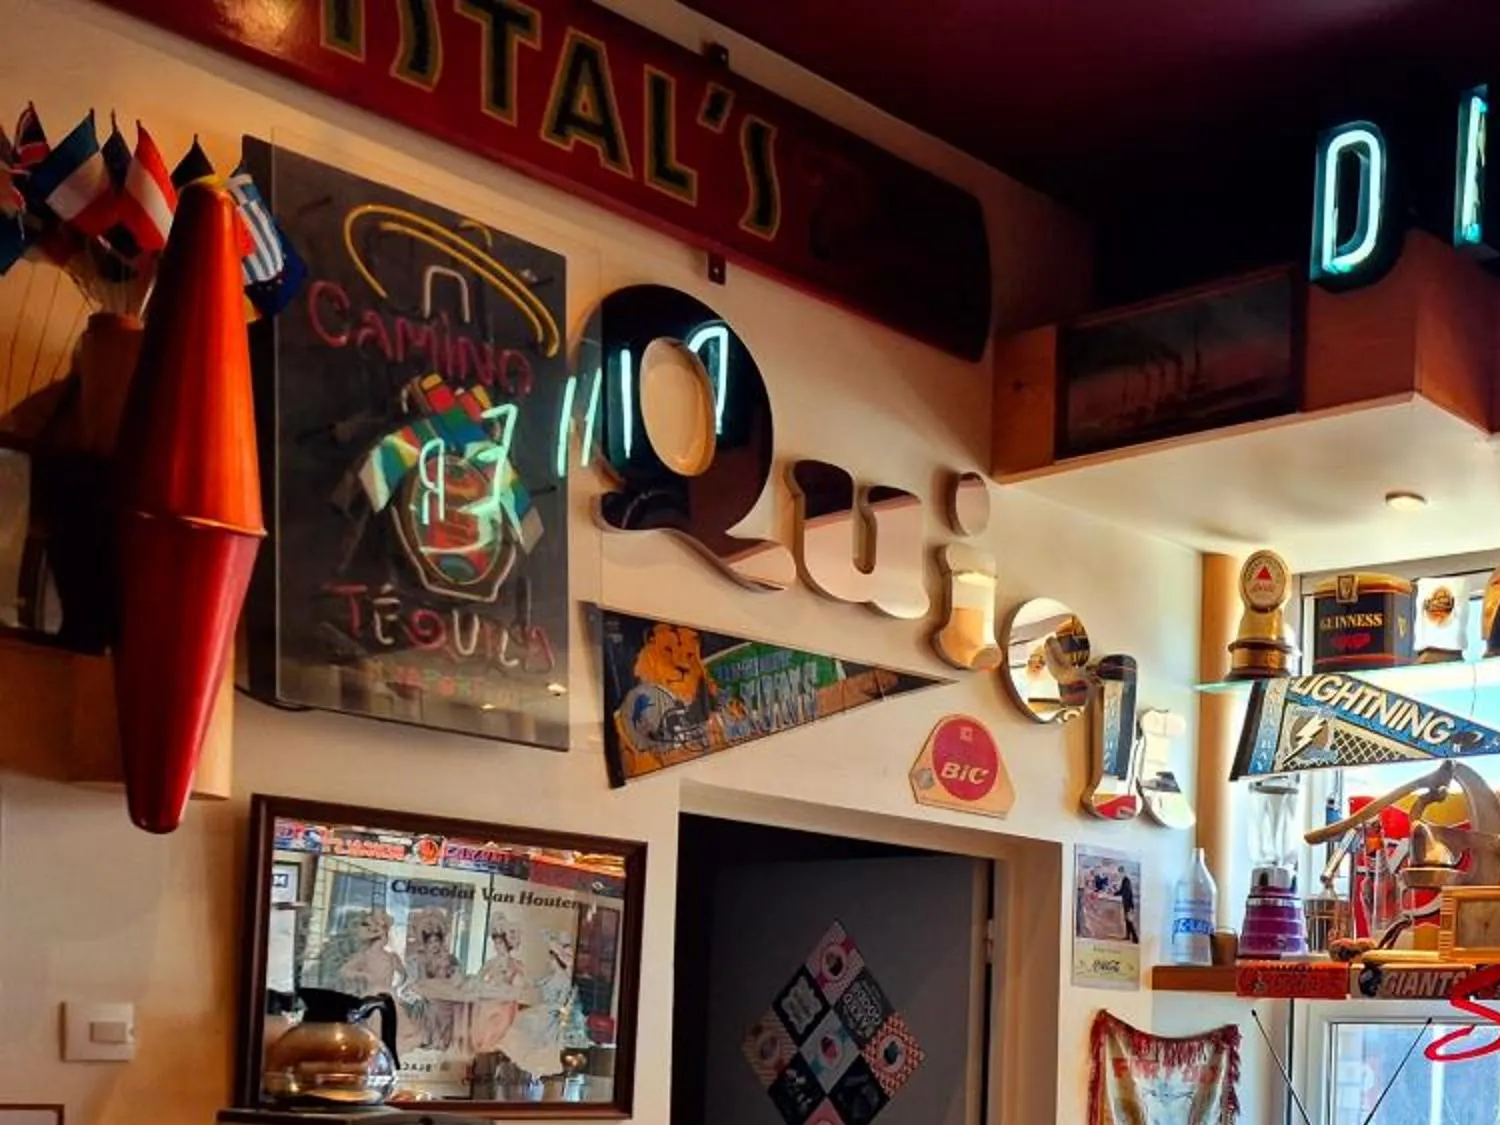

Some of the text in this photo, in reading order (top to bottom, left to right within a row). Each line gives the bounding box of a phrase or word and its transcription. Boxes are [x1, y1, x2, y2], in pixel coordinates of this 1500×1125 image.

[1319, 612, 1384, 630] GUINNESS
[1291, 674, 1455, 745] LIGHTNING
[390, 878, 475, 901] Chocolat
[481, 887, 516, 904] Van
